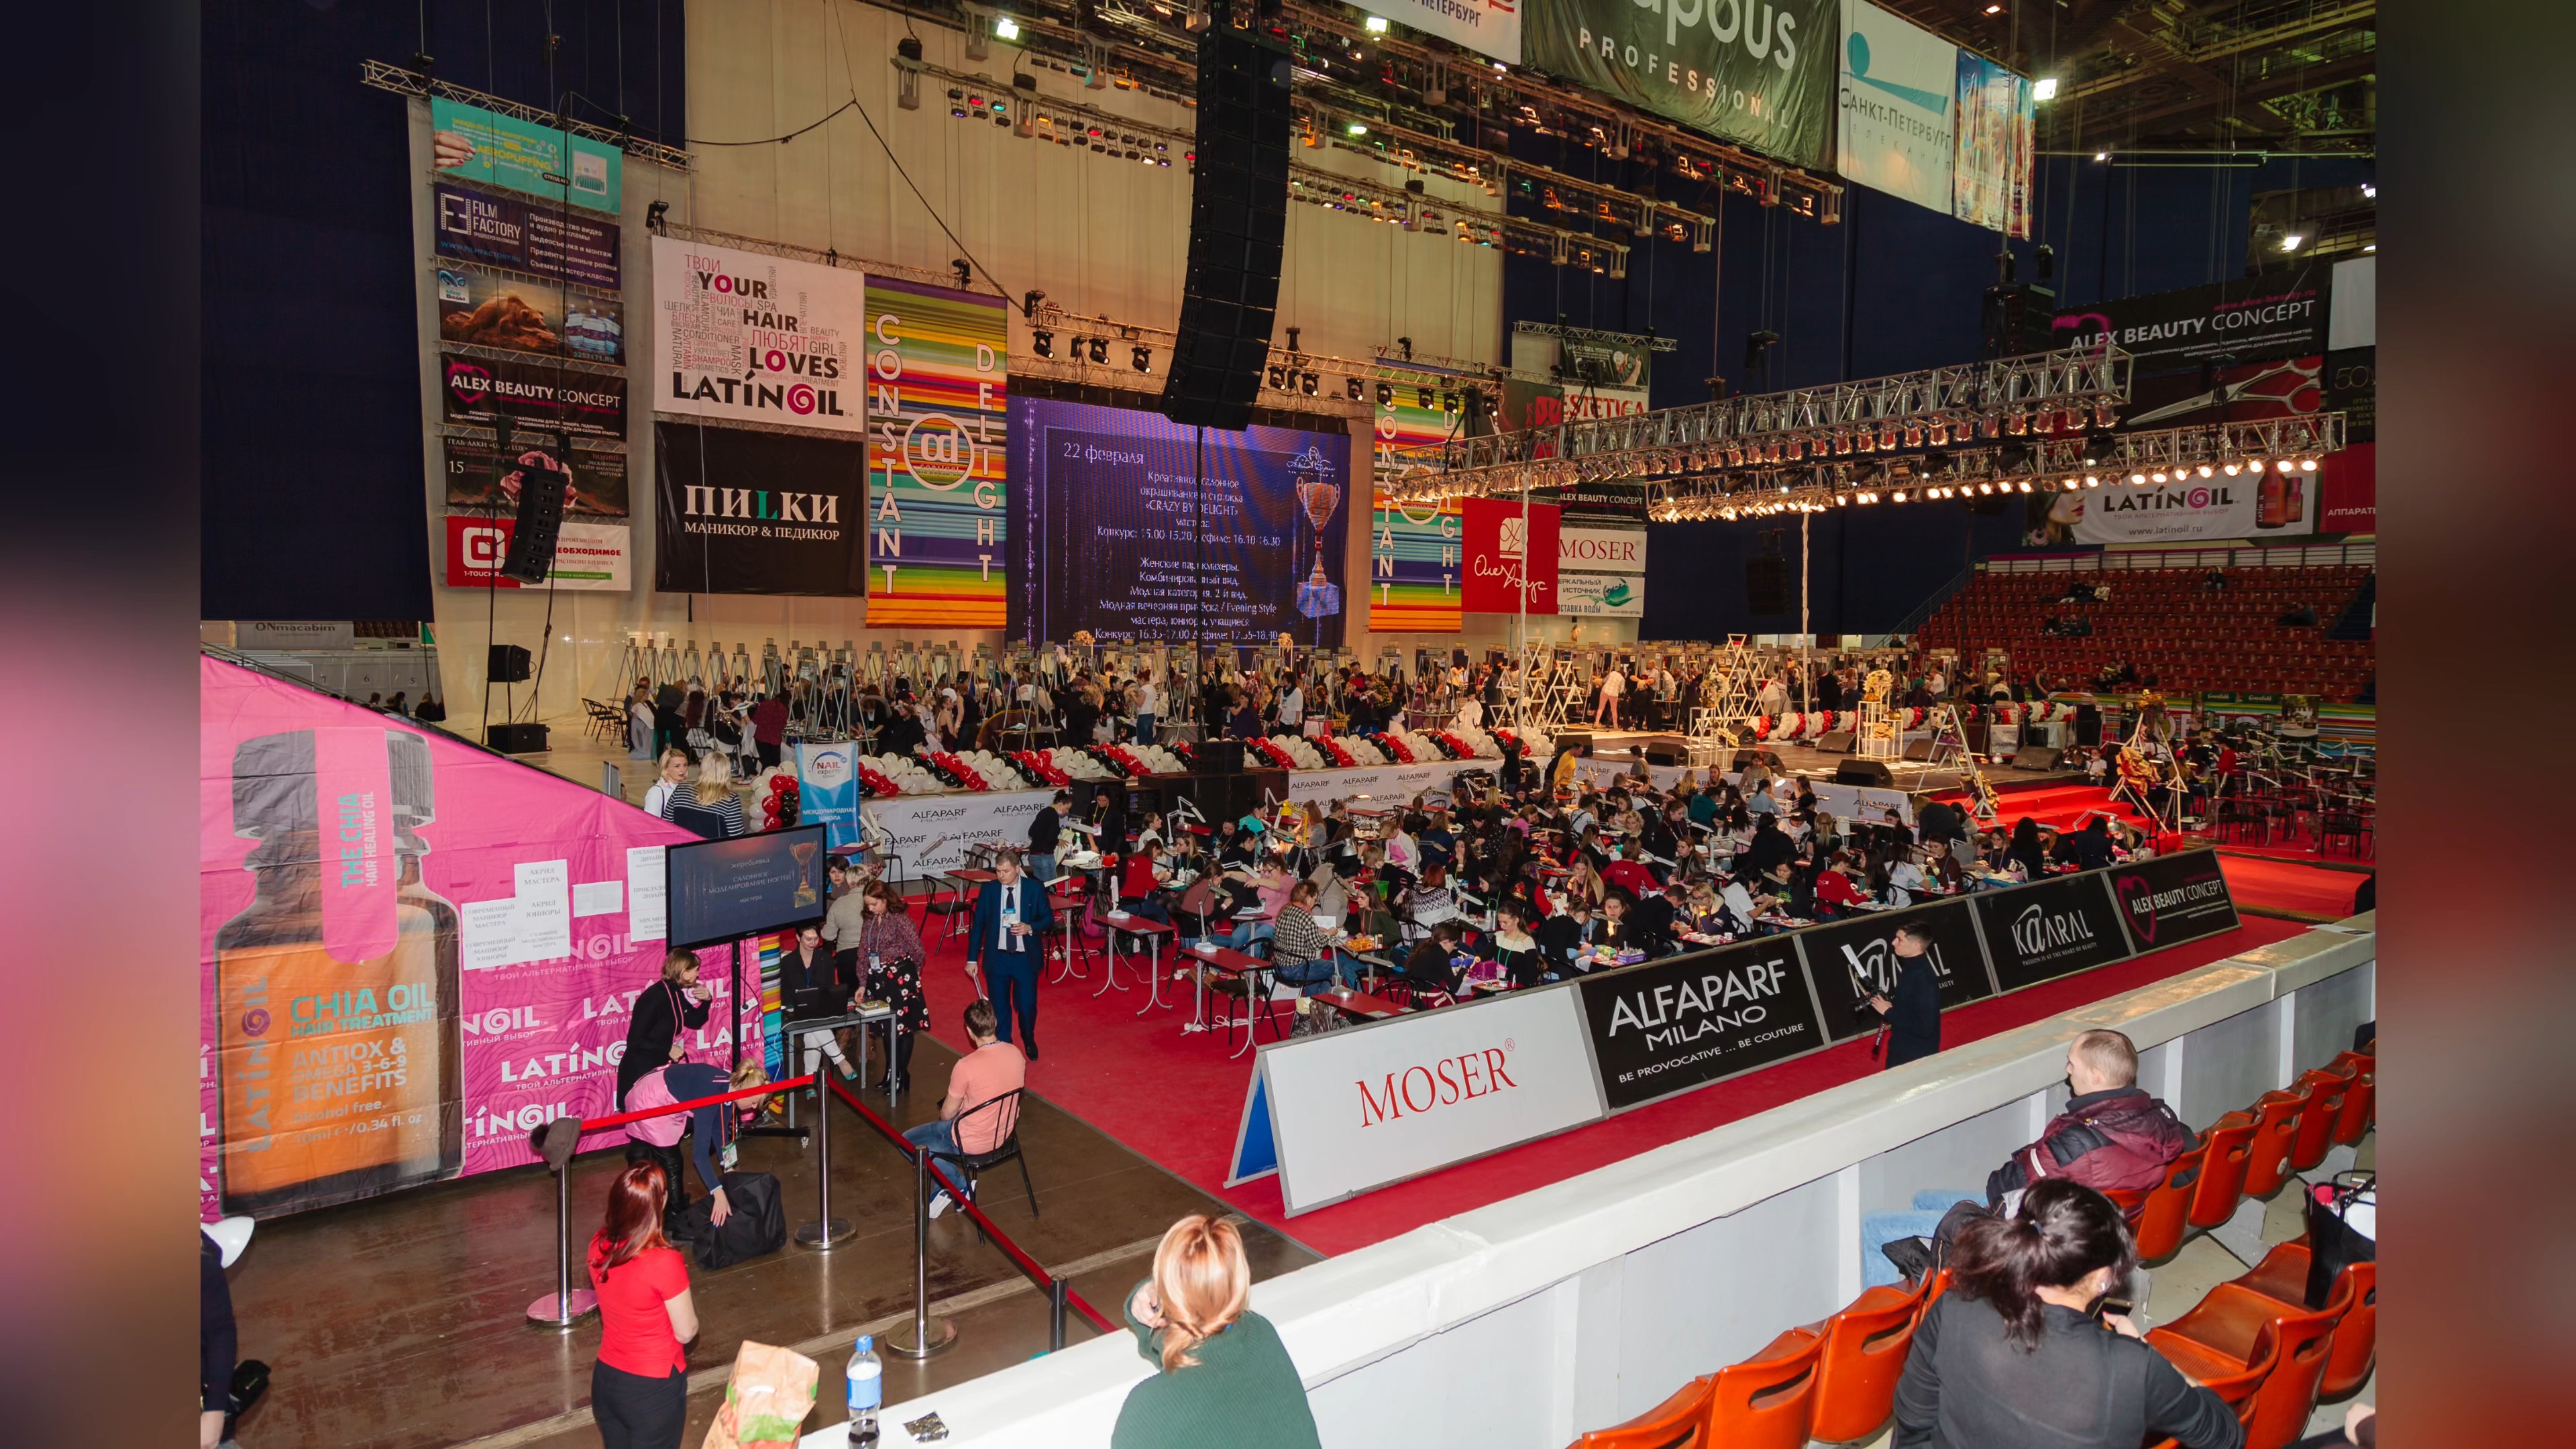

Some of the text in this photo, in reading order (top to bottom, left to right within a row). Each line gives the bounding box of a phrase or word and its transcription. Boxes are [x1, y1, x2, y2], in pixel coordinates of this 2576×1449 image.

[1579, 27, 1788, 128] PROFESSIONAL
[473, 201, 497, 219] FILM
[474, 217, 521, 239] FACTORY
[536, 223, 556, 234] аудио
[582, 226, 602, 237] видео
[586, 247, 612, 258] монтаж
[684, 254, 720, 273] ТВОИ
[698, 271, 768, 299] YOUR
[664, 301, 692, 313] ШЕЛК
[710, 292, 753, 309] ВОЛОСЫ
[757, 300, 777, 313] SPA
[672, 311, 701, 323] БЛЕСК
[701, 291, 709, 332] GLAMOUR
[716, 306, 735, 317] ЧИА
[718, 319, 736, 327] CARE
[743, 309, 798, 333] HAIR
[2125, 317, 2206, 344] BEAUTY
[2212, 300, 2315, 331] CONCEPT
[683, 329, 740, 343] CONDITIONER
[811, 327, 839, 337] BEAUTY
[672, 328, 682, 370] NATURAL
[751, 330, 808, 352] ЛЮБЯТ
[810, 341, 837, 356] GIRL
[683, 337, 691, 370] VITAMIN
[692, 354, 732, 366] SHAMPOO
[731, 345, 741, 375] MASK
[692, 364, 729, 374] COSMETICS
[749, 347, 839, 378] LOVES
[802, 376, 839, 387] TREATMENT
[451, 375, 620, 409] ALEX BEAUTY CONCEPT
[875, 314, 902, 594] CONSTANT
[973, 343, 998, 582] DELIGHT
[1064, 442, 1144, 466] 22 февраля
[449, 461, 464, 474] 15
[1183, 502, 1195, 513] BY
[1578, 494, 1643, 504] BEAUTY CONCEPT
[684, 521, 839, 541] МАНИКЮР & ПЕДИКЮР
[2129, 525, 2203, 535] www.latinoil.ru
[557, 547, 621, 556] ЕОБХОДИМОЕ
[1559, 539, 1636, 561] MOSER
[1140, 557, 1179, 568] Женские
[1585, 605, 1601, 613] ВОДЫ
[364, 675, 370, 683] 6
[1291, 780, 1330, 790] ALFAPARF
[1342, 775, 1379, 785] ALFAPARF
[1397, 772, 1432, 781] ALFAPARF
[912, 808, 967, 820] ALFAPARF
[994, 804, 1045, 814] ALFAPARF
[338, 792, 364, 890] THE CHIA
[362, 791, 378, 888] HAIR HEALING OIL
[525, 877, 560, 885] МАСТЕРА
[708, 877, 766, 894] МОДЕЛИРОВАНИЕ
[739, 894, 762, 903] мастера
[2132, 896, 2154, 914] ALEX
[2152, 888, 2186, 910] BEAUTY
[2186, 879, 2224, 901] CONCEPT
[2062, 948, 2076, 956] HEART
[522, 961, 603, 978] АЛЬТЕРНАТИВНЫЙ
[606, 957, 634, 966] ВЫБОР
[290, 982, 437, 1023] CHIA OIL
[1609, 959, 1786, 1037] ALFAPARF
[290, 1009, 433, 1038] HAIR TREATMENT
[596, 1016, 619, 1026] ТВОЙ
[1646, 1006, 1766, 1052] MILANO
[504, 1030, 535, 1041] ВЫБОР
[292, 1037, 407, 1070] ANTIOX &
[1619, 1023, 1805, 1083] BE PROVOCATIVE BE COUTURE
[291, 1056, 407, 1083] OMEGA 3-6-9
[292, 1069, 407, 1103] BENEFITS
[516, 1081, 541, 1090] ТВОЙ
[1355, 1048, 1518, 1128] MOSER
[292, 1102, 348, 1125] Alcohol
[294, 1129, 330, 1146] 10ml
[408, 1114, 423, 1125] oz
